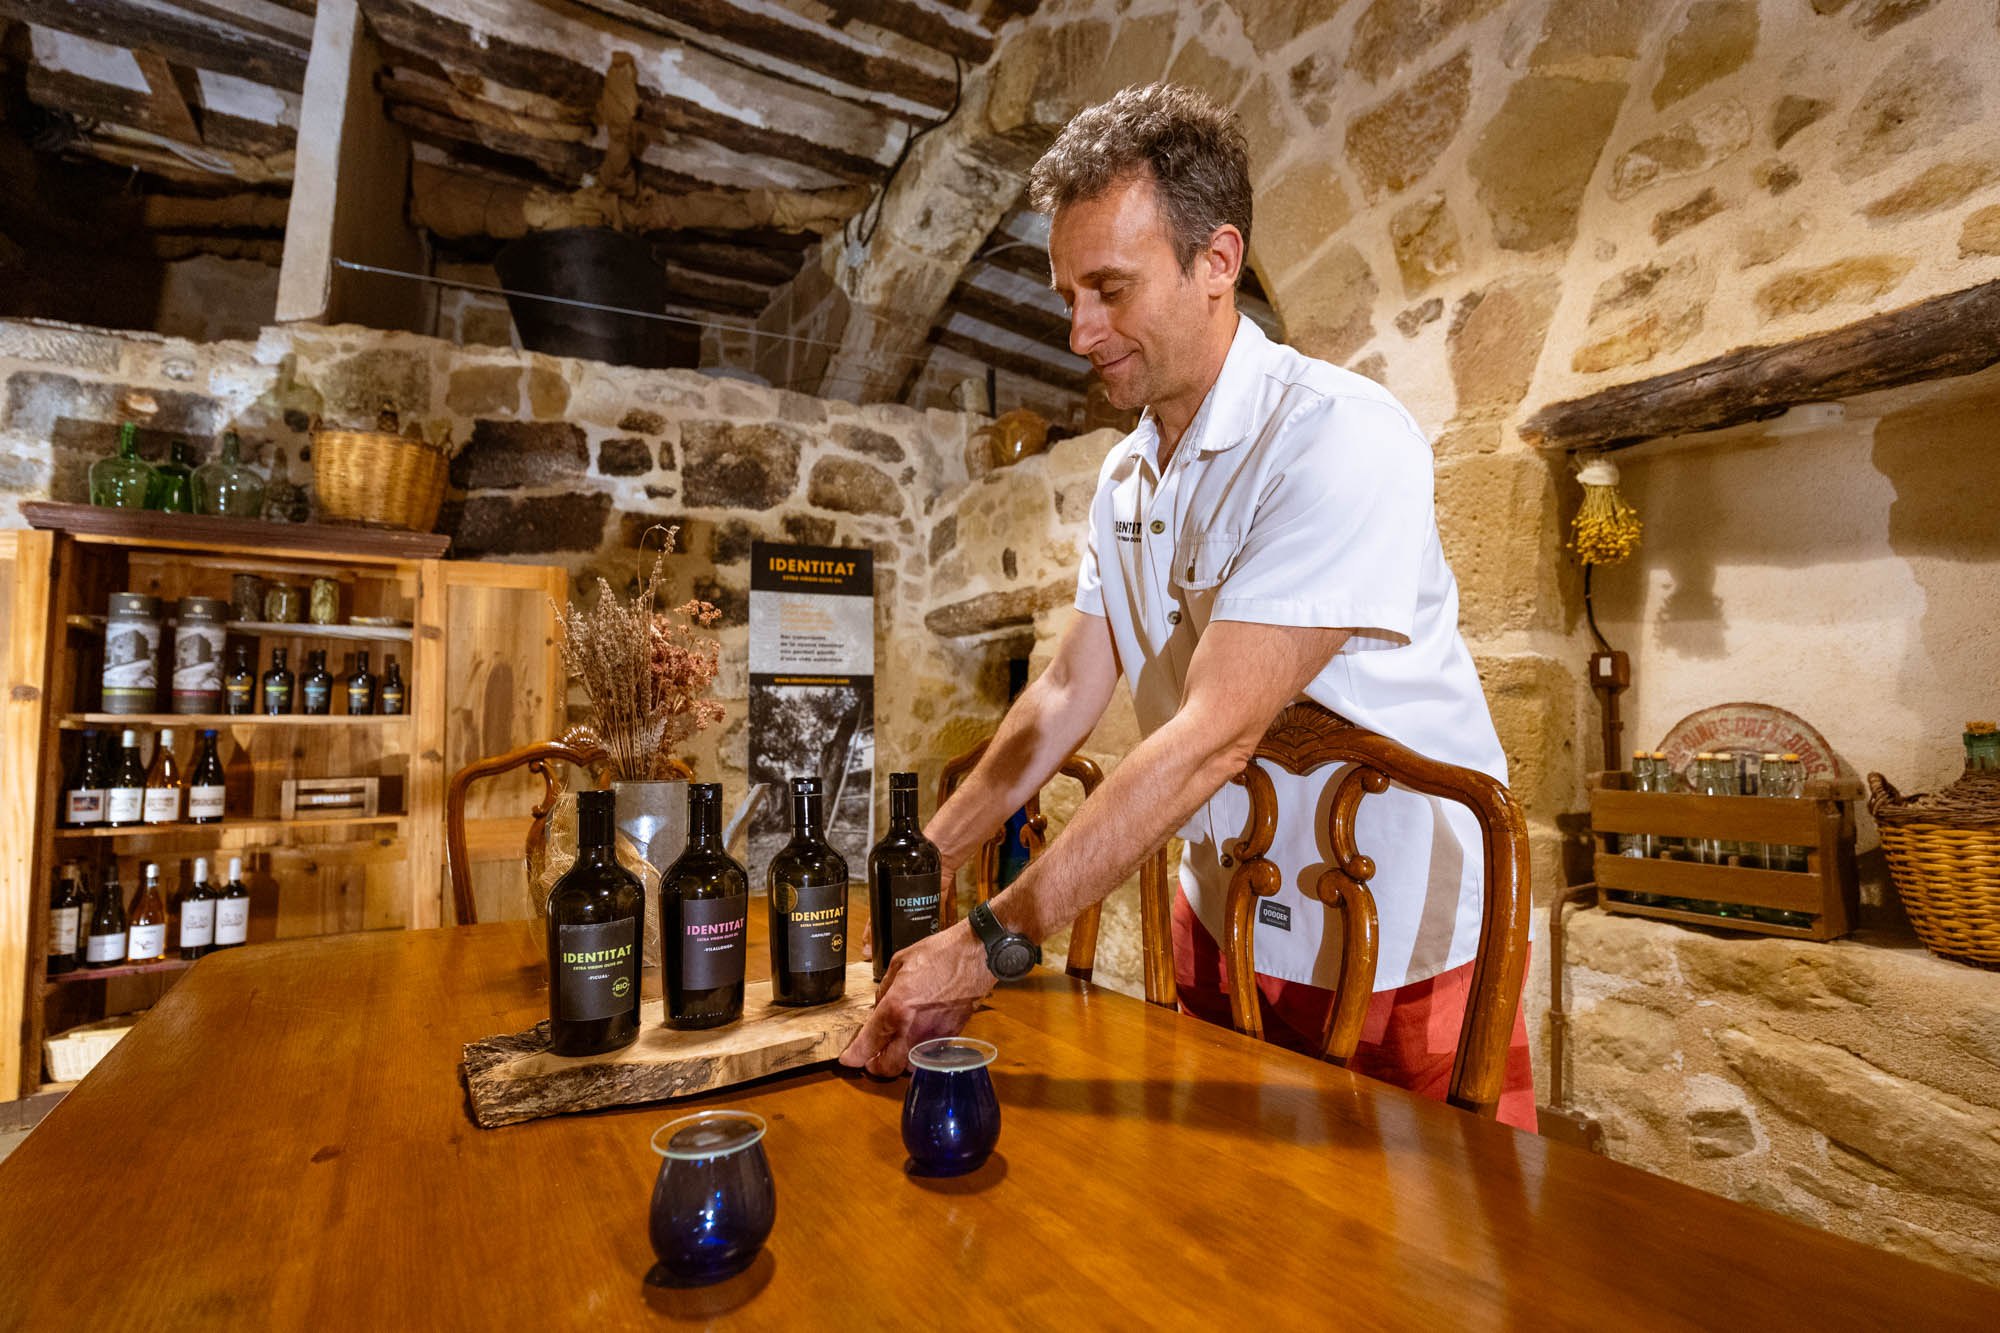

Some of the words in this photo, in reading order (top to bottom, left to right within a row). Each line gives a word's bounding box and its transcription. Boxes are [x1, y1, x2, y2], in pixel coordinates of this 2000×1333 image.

[769, 557, 856, 576] IDENTITAT
[895, 893, 940, 907] IDENTITAT
[791, 906, 845, 922] IDENTITAT
[686, 918, 745, 936] IDENTITAT
[562, 943, 632, 964] IDENTITAT
[615, 981, 628, 992] BIO
